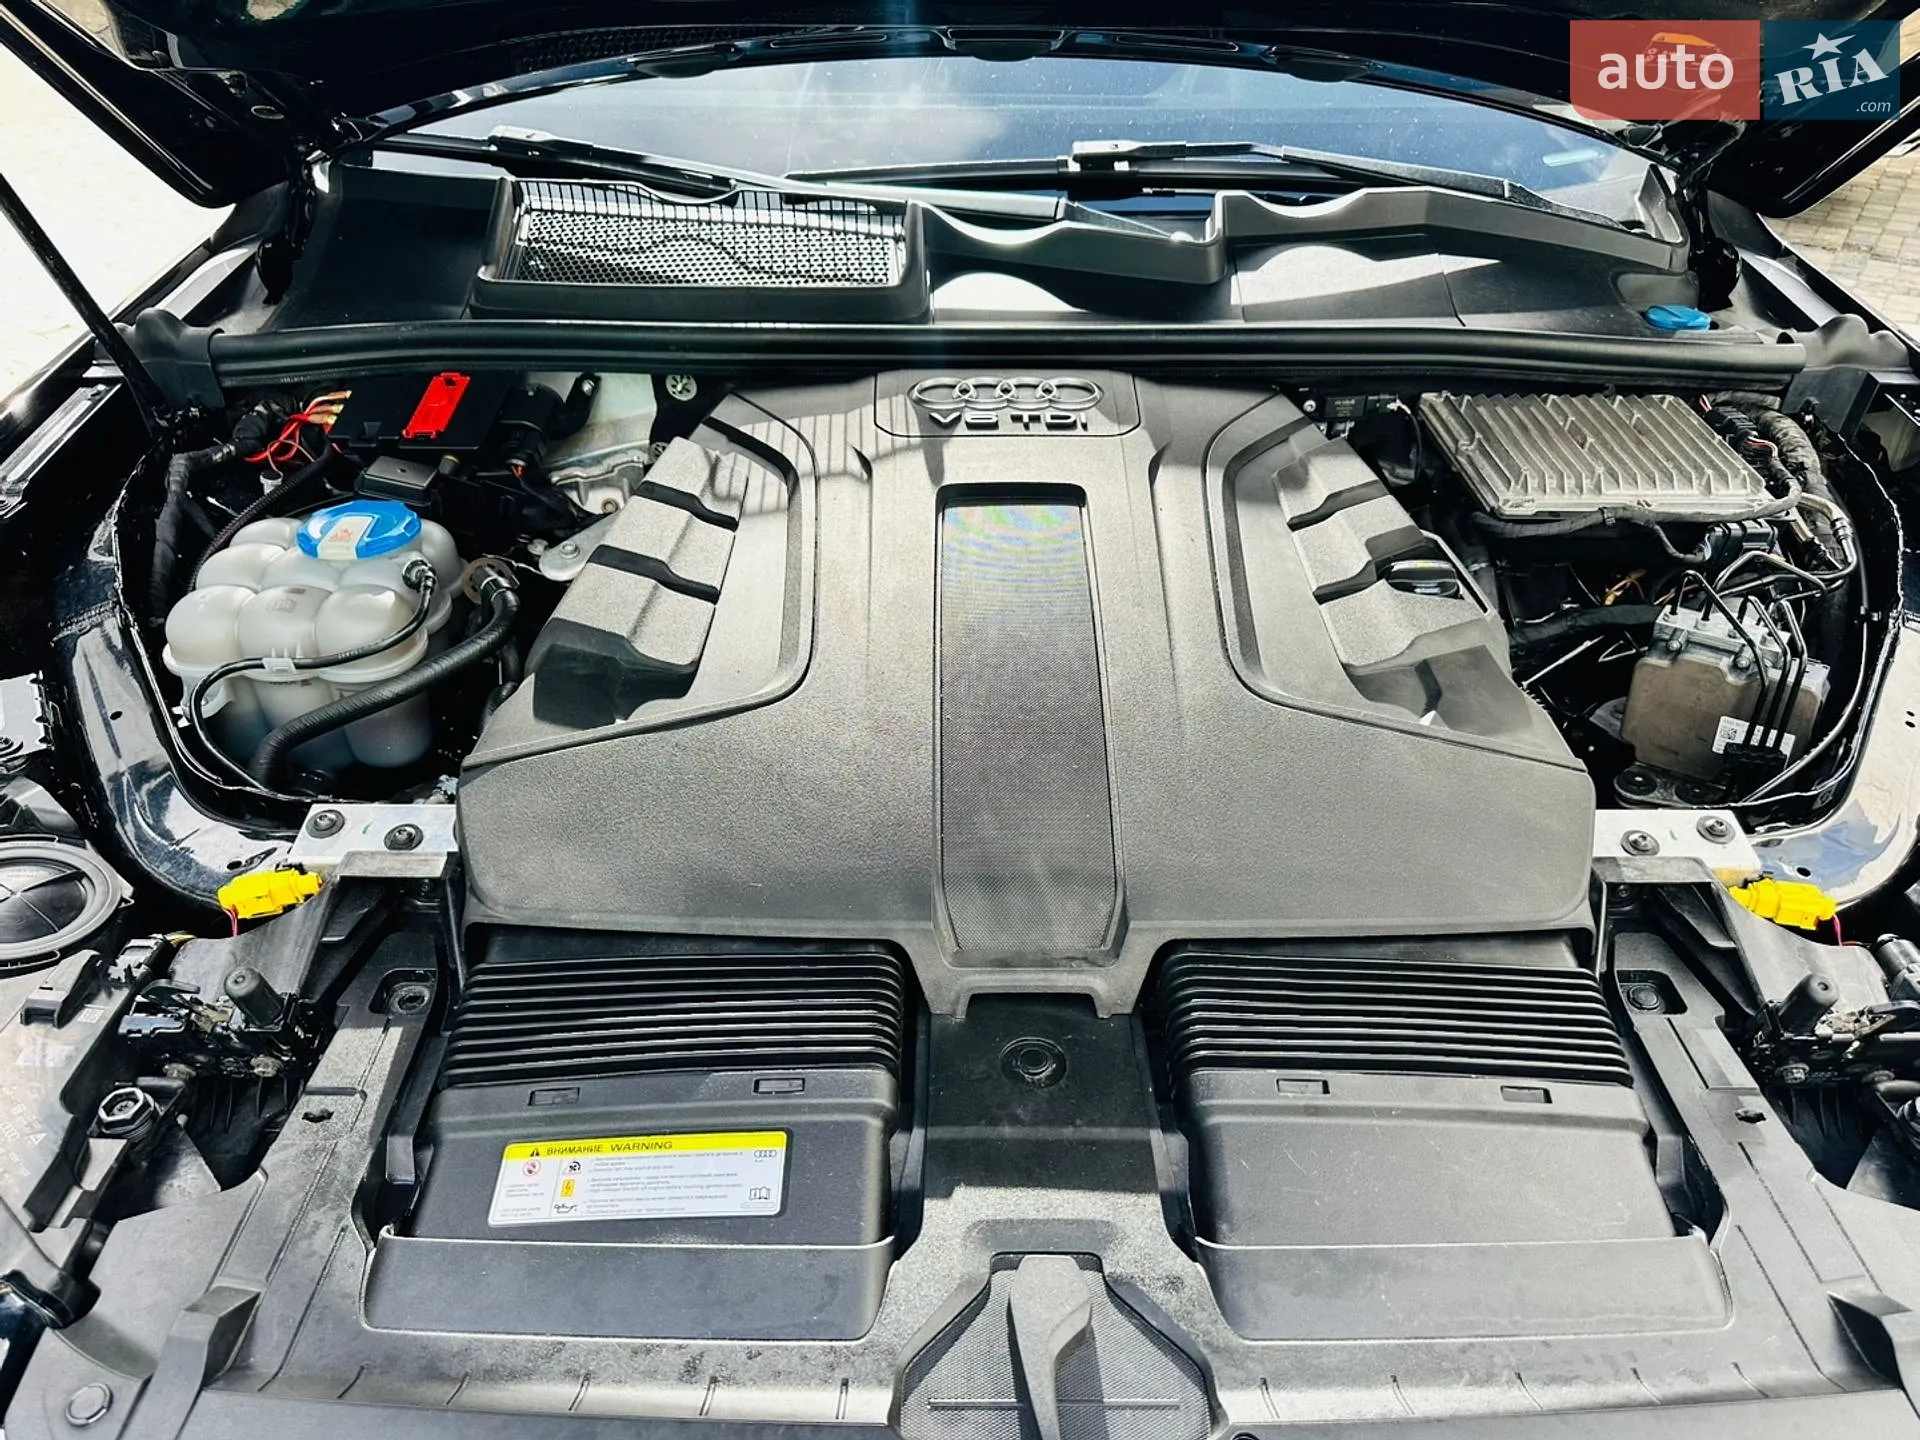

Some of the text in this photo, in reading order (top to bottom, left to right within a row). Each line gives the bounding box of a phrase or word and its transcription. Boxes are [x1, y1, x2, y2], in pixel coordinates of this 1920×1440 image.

[928, 411, 1089, 432] V6 TDI
[546, 1143, 604, 1156] ВНИМАНИЕ
[609, 1140, 673, 1153] WARNING
